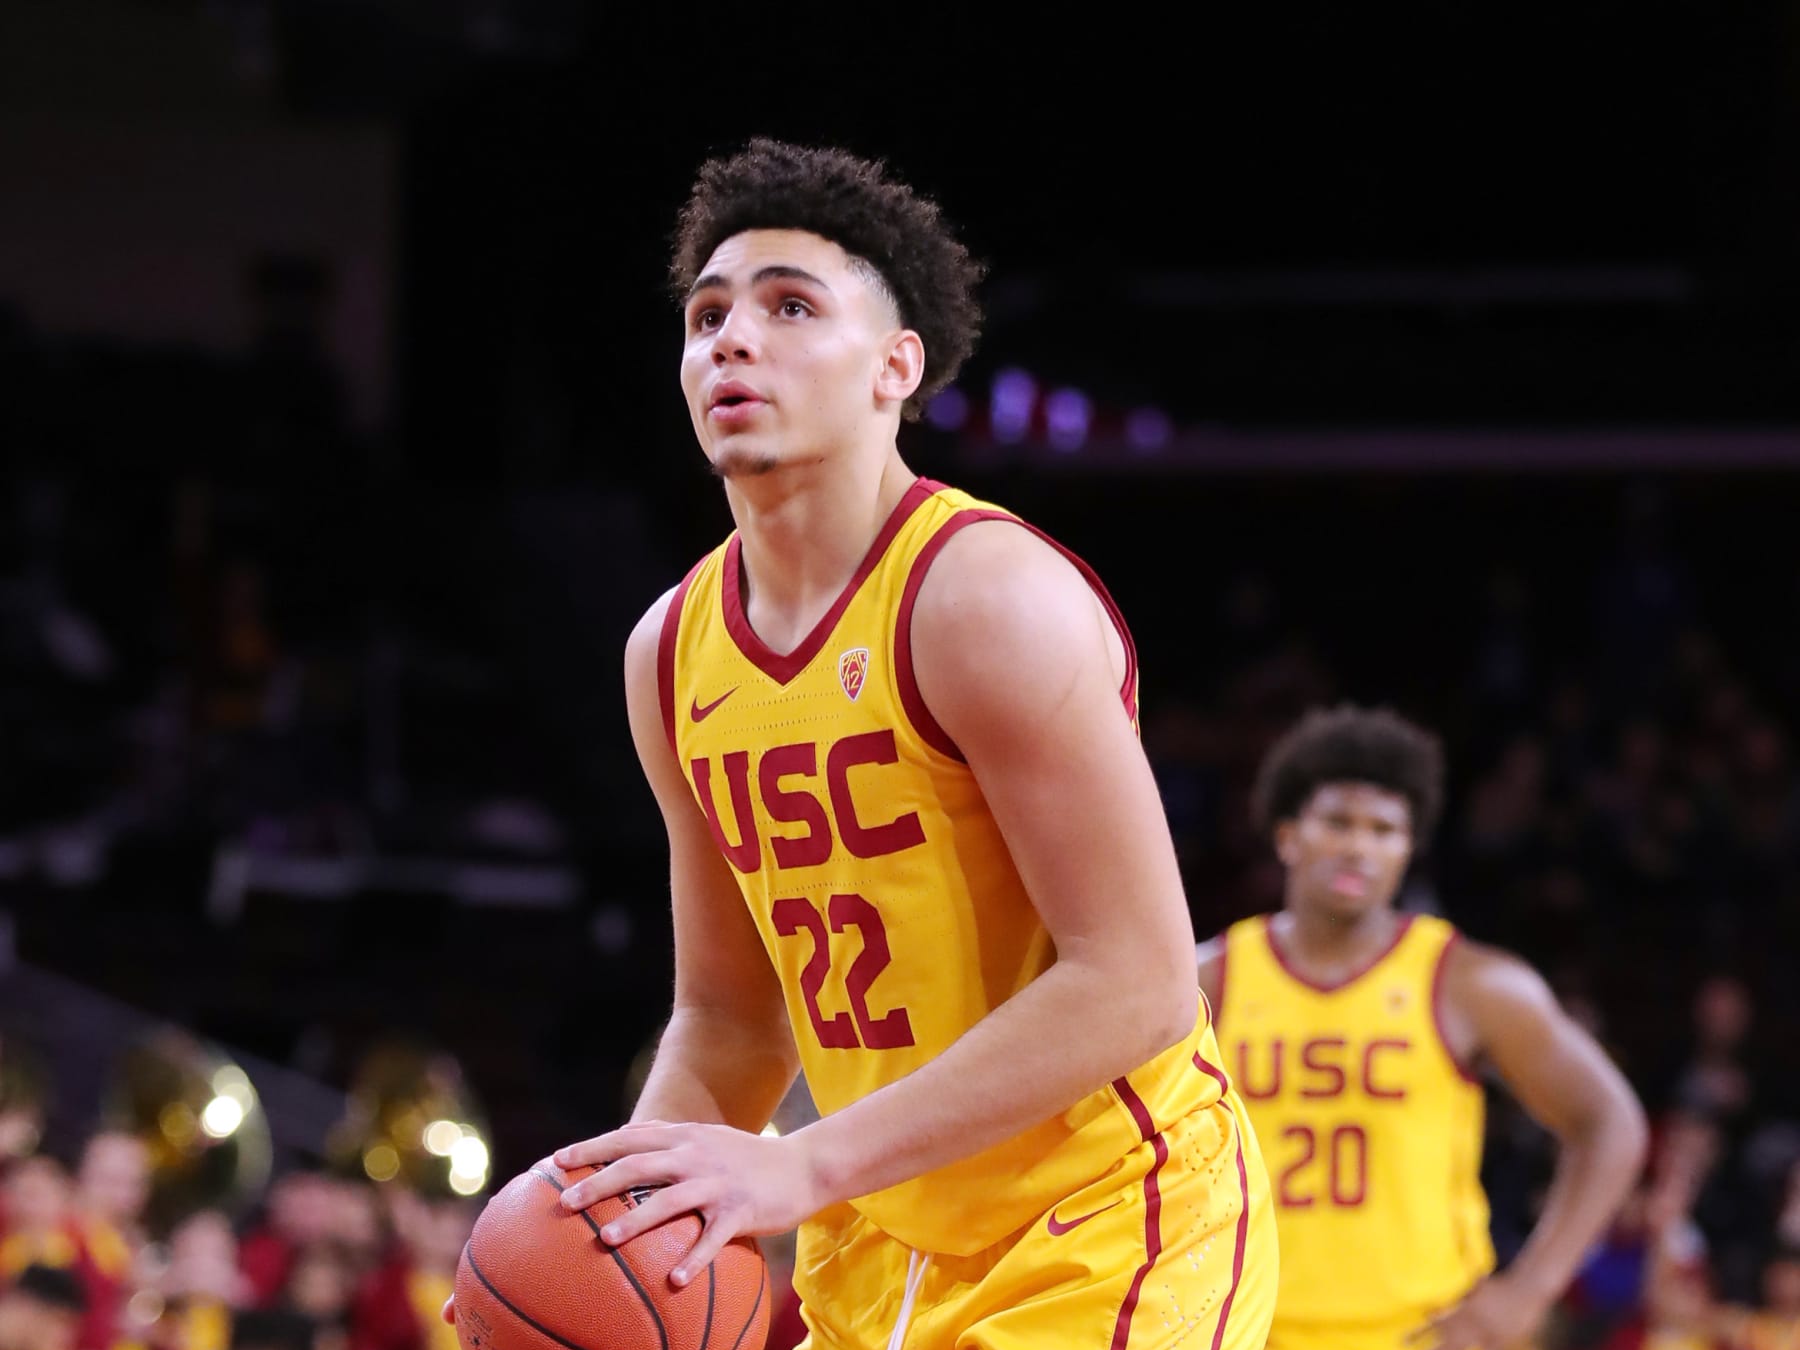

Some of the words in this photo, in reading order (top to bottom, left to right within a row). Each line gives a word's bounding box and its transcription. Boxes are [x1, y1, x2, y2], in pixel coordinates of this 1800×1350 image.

[841, 652, 866, 682] PAC
[846, 670, 860, 691] 12
[690, 728, 926, 874] USC
[771, 893, 915, 1050] 22
[1236, 1037, 1410, 1101] USC
[1277, 1124, 1368, 1208] 20
